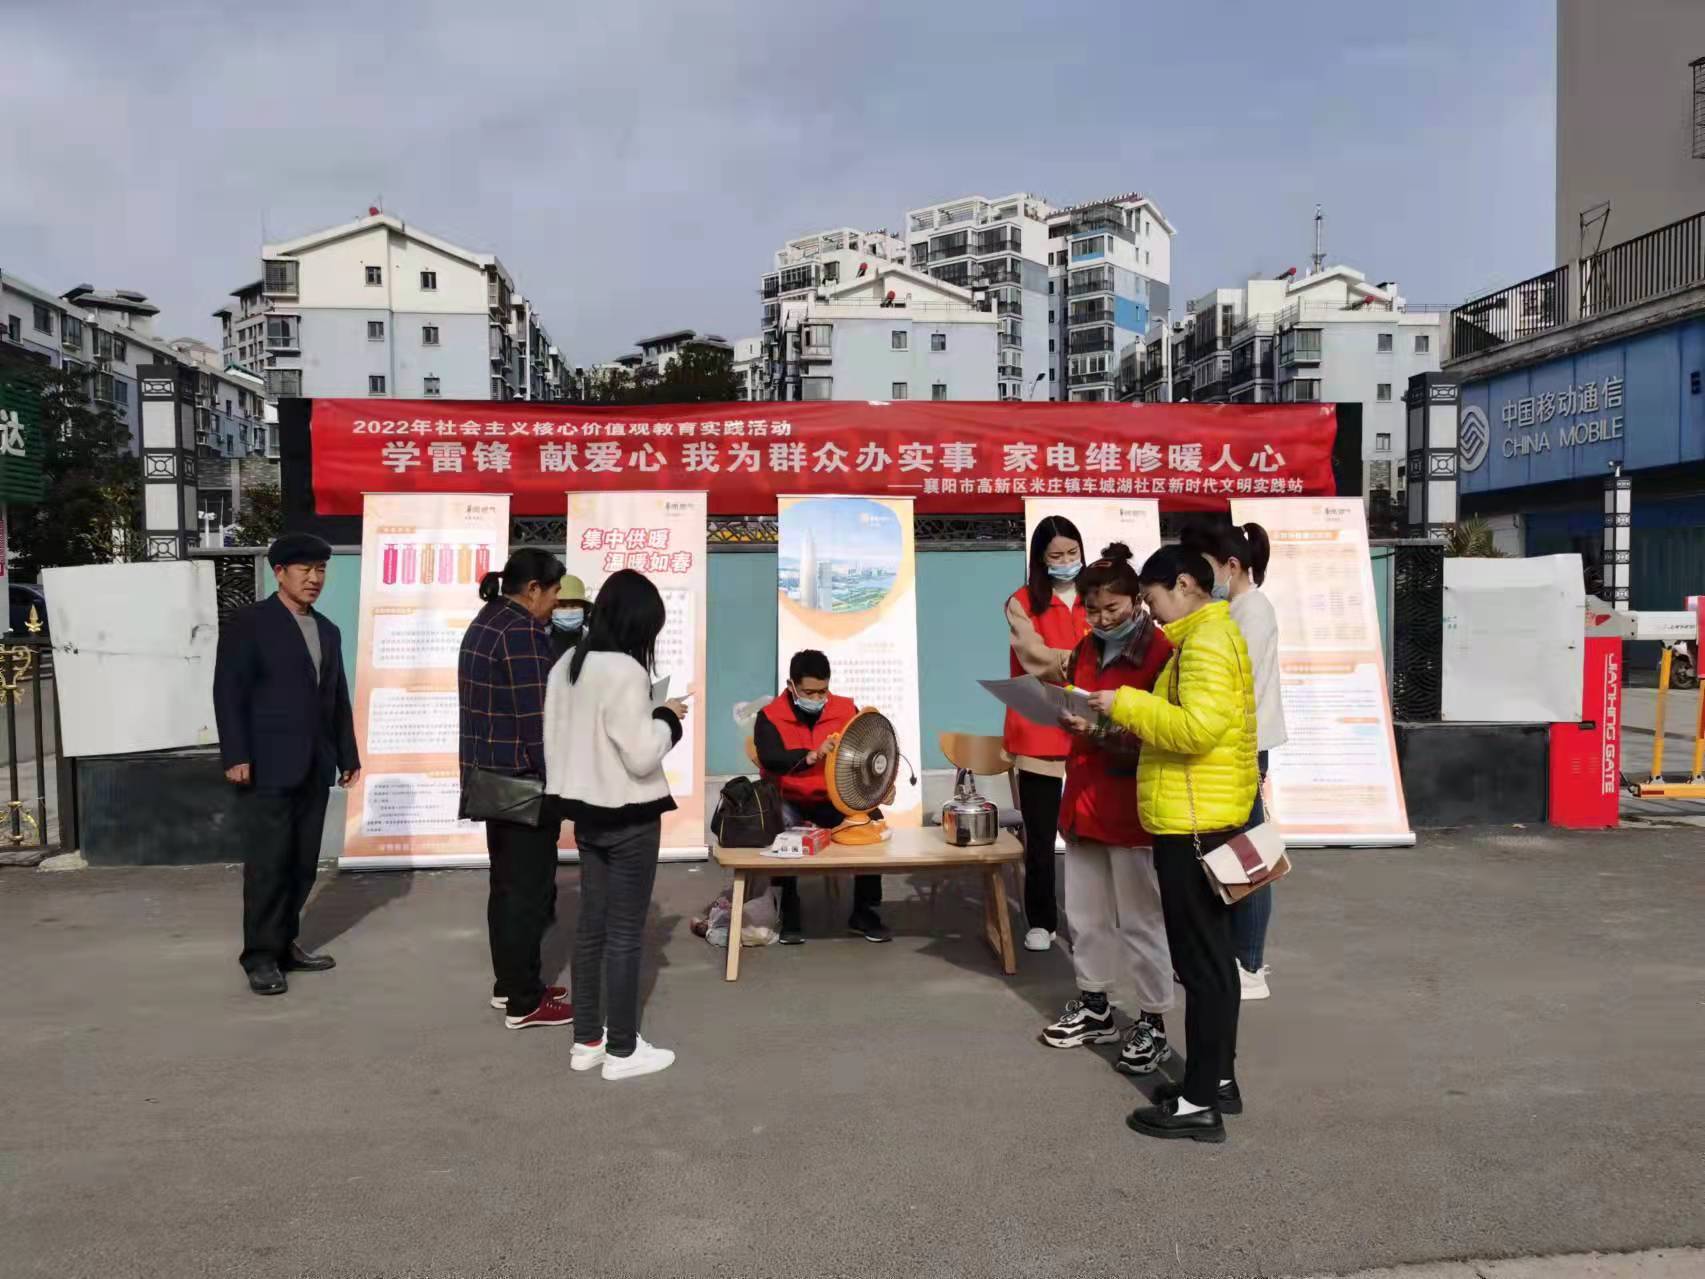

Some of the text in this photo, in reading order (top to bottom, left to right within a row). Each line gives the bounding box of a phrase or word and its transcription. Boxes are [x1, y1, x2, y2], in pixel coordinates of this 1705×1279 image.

[1502, 376, 1625, 430] 中国移动通信
[352, 418, 792, 437] 2022年社会主义核心价值观教育实践活动
[1502, 416, 1625, 458] CHINA MOBILE
[381, 441, 1286, 474] 学雷锋 献爱心 我为群众办实事 家电维修暖人心
[581, 528, 671, 550] 集中供暖
[603, 551, 693, 574] 温暖如春
[1604, 743, 1616, 793] GATE
